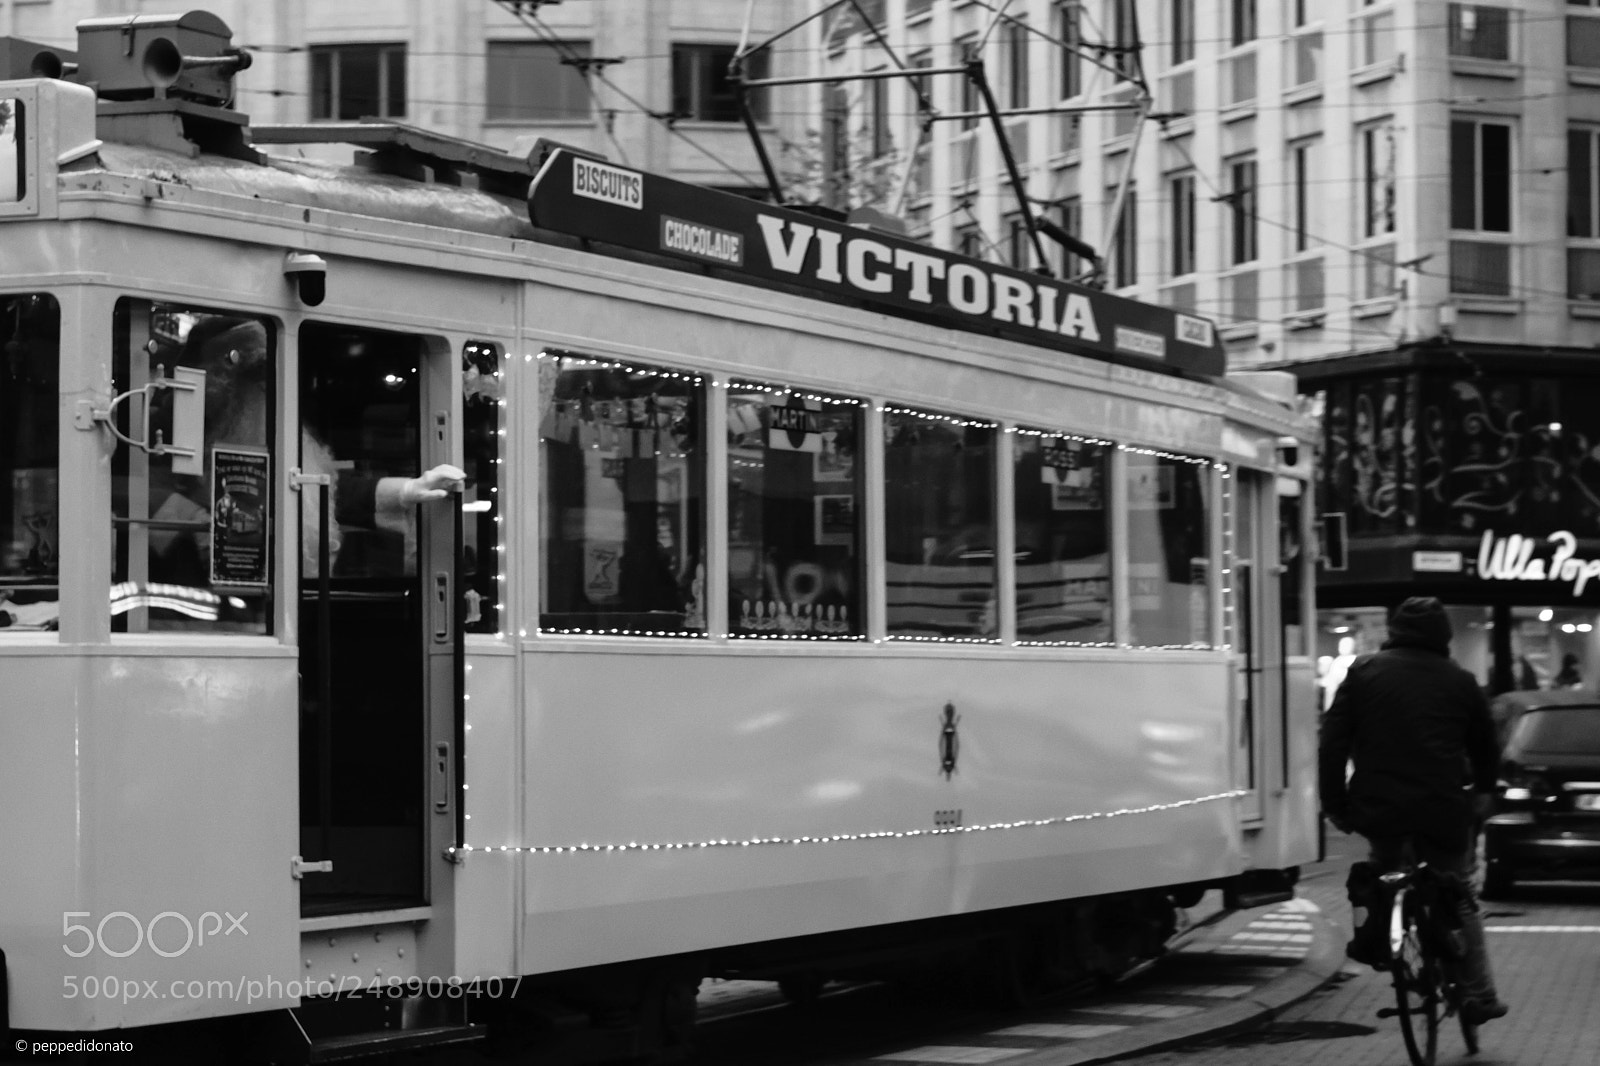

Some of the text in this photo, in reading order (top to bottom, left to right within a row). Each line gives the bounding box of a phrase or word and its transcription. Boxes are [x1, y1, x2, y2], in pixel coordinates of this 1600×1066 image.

[576, 163, 641, 204] BISCUITS
[665, 219, 740, 263] CHOCOLADE
[757, 213, 1101, 342] VICTORIA
[1477, 529, 1600, 597] Ulla Pop
